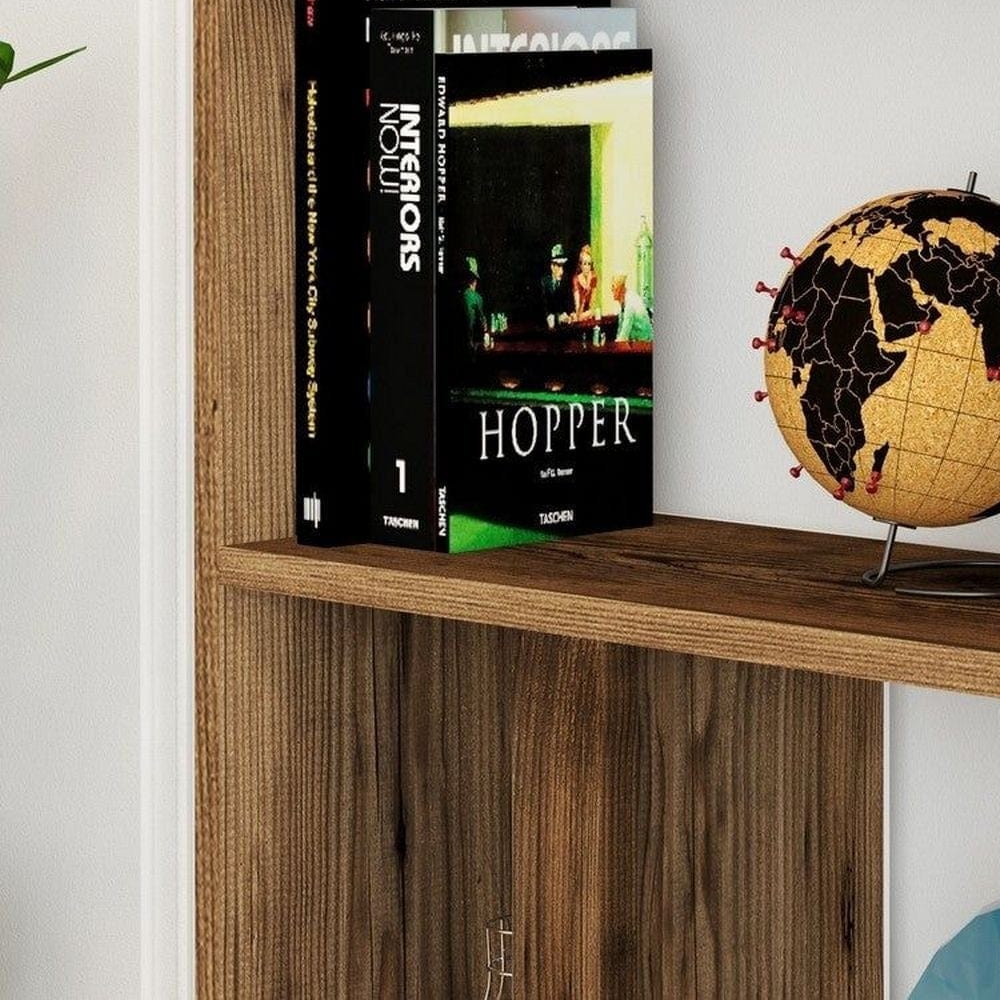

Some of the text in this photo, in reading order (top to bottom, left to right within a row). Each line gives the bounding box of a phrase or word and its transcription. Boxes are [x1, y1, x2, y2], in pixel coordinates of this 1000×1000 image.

[379, 103, 400, 194] NOW!
[437, 76, 447, 203] EDWARD HOPPER
[399, 103, 421, 273] INTERIORS
[306, 211, 318, 244] New
[479, 397, 637, 461] HOPPER
[395, 458, 406, 494] 1
[383, 514, 419, 531] TASCHEN
[437, 485, 447, 537] TASCHEN
[539, 509, 574, 525] TASCHEN
